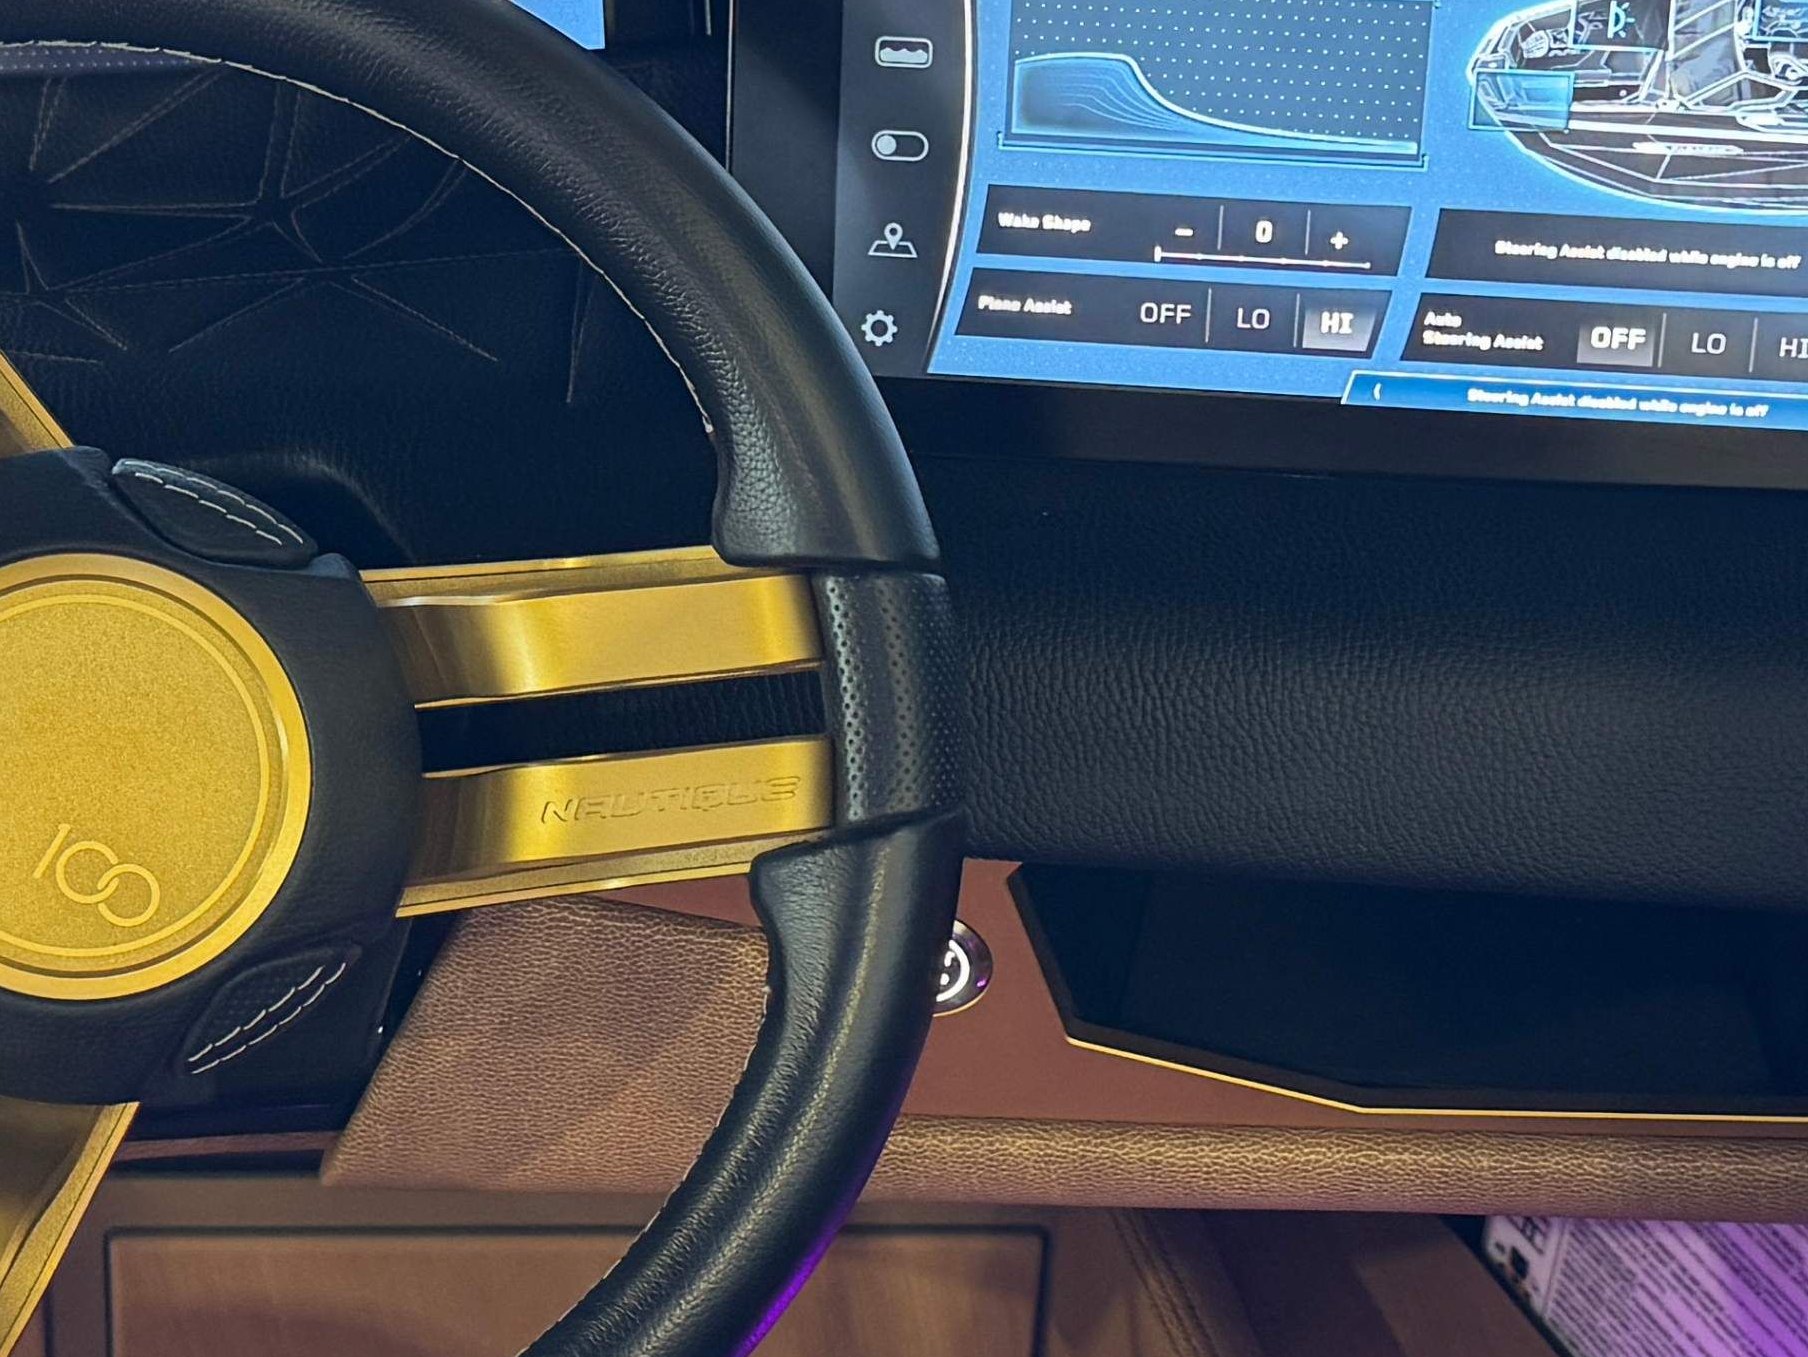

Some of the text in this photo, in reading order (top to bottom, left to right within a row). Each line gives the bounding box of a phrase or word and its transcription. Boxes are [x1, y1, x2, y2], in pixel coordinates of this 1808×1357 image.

[998, 213, 1091, 234] Wake Shape
[1255, 220, 1273, 243] 0
[978, 294, 1072, 316] Plane Assist
[1140, 301, 1191, 324] OFF
[1236, 307, 1270, 330] LO
[1320, 311, 1354, 334] HI
[1423, 311, 1462, 328] Auto
[1423, 329, 1544, 351] Steering Assist
[1591, 326, 1646, 350] OFF
[1692, 332, 1727, 355] LO
